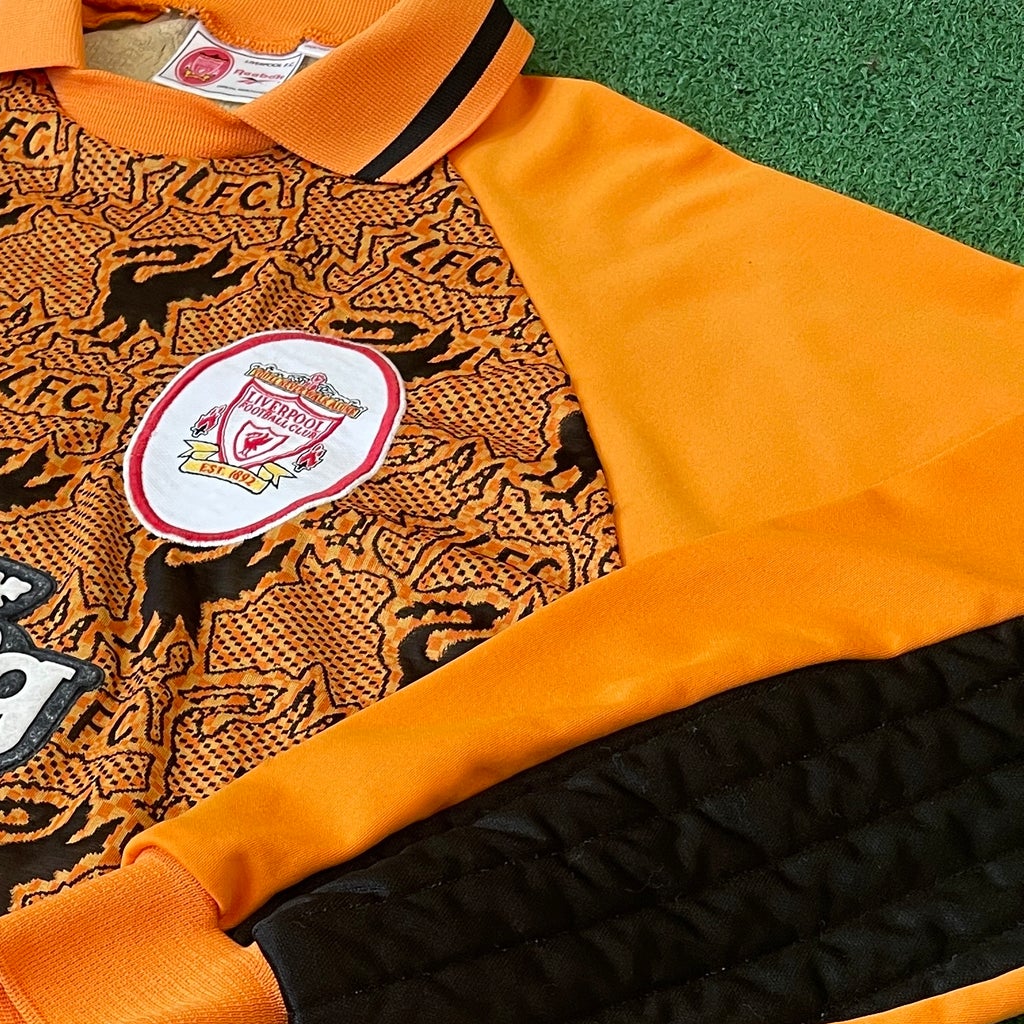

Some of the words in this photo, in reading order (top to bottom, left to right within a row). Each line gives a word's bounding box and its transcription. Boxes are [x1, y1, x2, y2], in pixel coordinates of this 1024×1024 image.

[238, 401, 288, 429] FOOTBALL
[246, 391, 325, 433] LIVERPOOL
[228, 469, 256, 487] 1892
